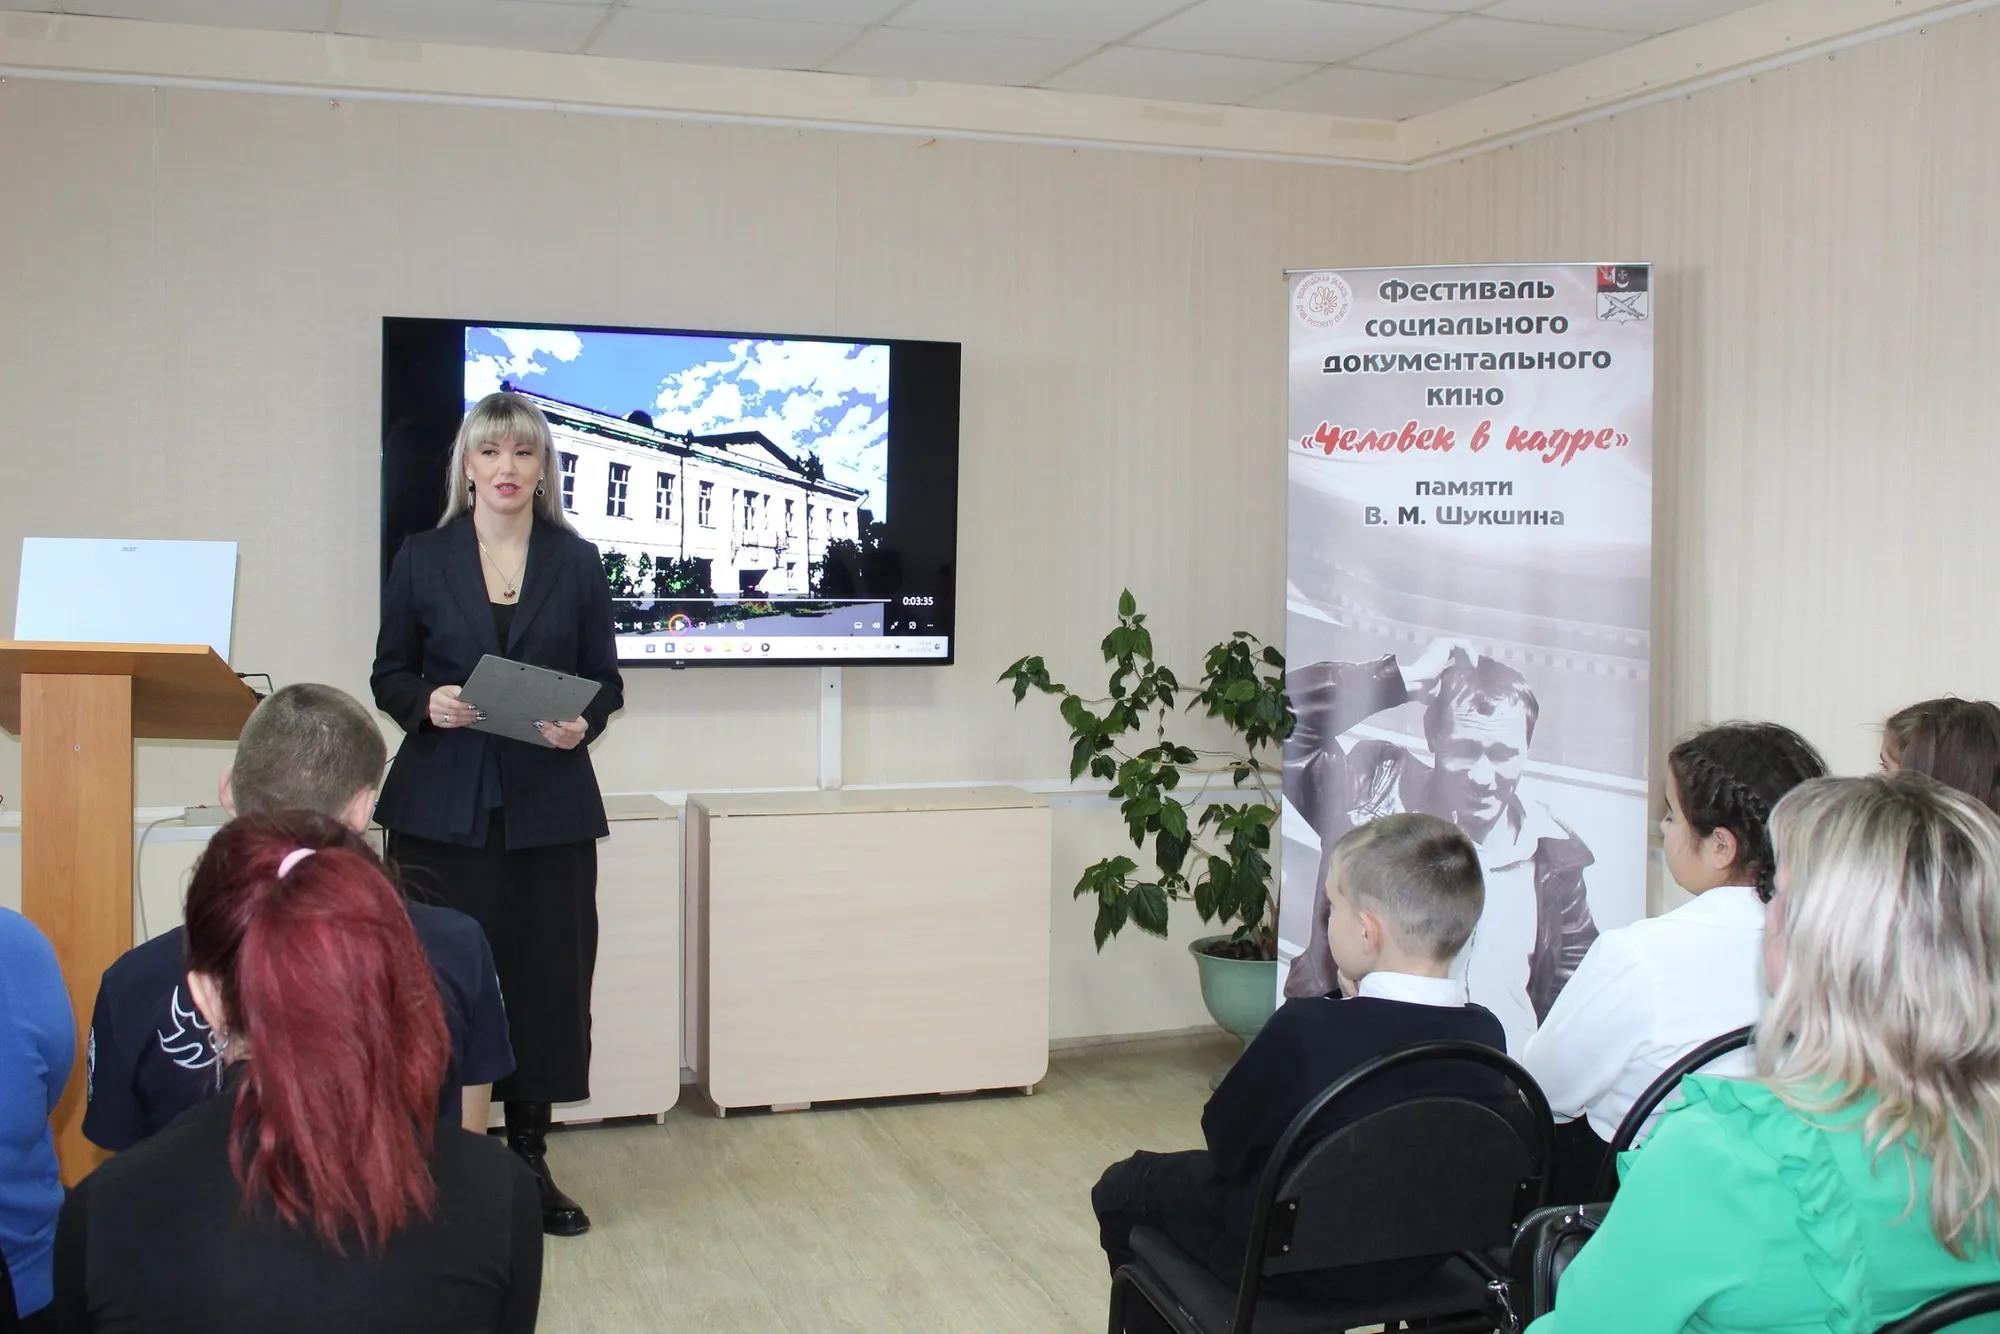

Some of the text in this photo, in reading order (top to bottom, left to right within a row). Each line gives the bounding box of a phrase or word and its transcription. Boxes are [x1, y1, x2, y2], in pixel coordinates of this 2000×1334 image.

[1379, 279, 1555, 303] Фестиваль
[1365, 315, 1569, 338] социального
[1322, 350, 1612, 374] документального
[1427, 387, 1504, 406] кино
[1301, 420, 1629, 466] «Человек в кадре»
[1415, 480, 1513, 496] памяти
[1365, 505, 1565, 527] В. М. Шукшина
[902, 596, 934, 606] 0:03:35
